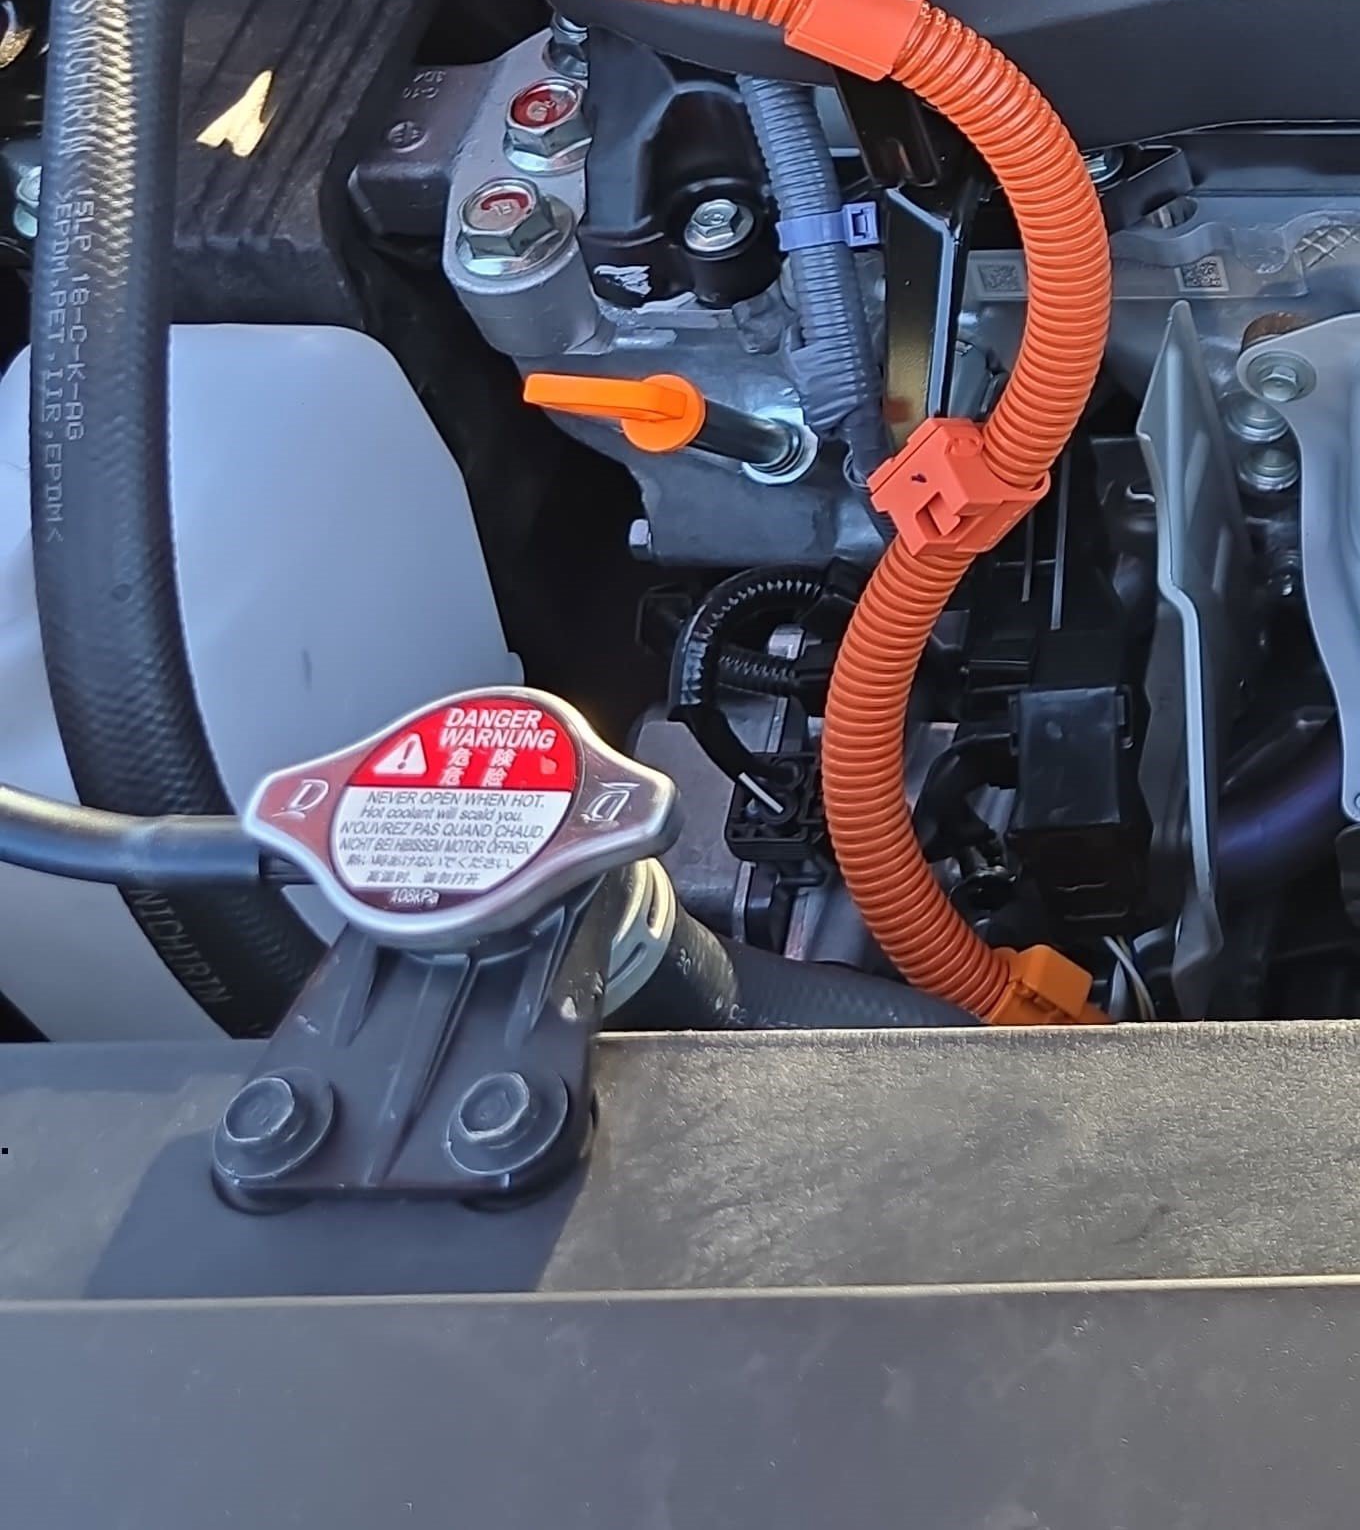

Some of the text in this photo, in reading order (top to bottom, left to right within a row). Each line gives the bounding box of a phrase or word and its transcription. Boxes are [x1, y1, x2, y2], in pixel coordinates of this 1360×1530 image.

[446, 708, 543, 729] DANGER
[438, 728, 557, 751] WARNUNG
[367, 791, 545, 808] NEVER OPEN WHEN HOT.
[360, 805, 386, 819] Hot
[386, 806, 435, 819] coolant
[436, 806, 459, 820] will
[459, 807, 496, 821] scald
[340, 820, 545, 839] N'OUVREZ PAS QUAND CHAUD.
[340, 837, 374, 851] NICHT
[374, 838, 394, 852] BEI
[395, 838, 444, 852] HEISSEM
[444, 838, 486, 853] MOTOR
